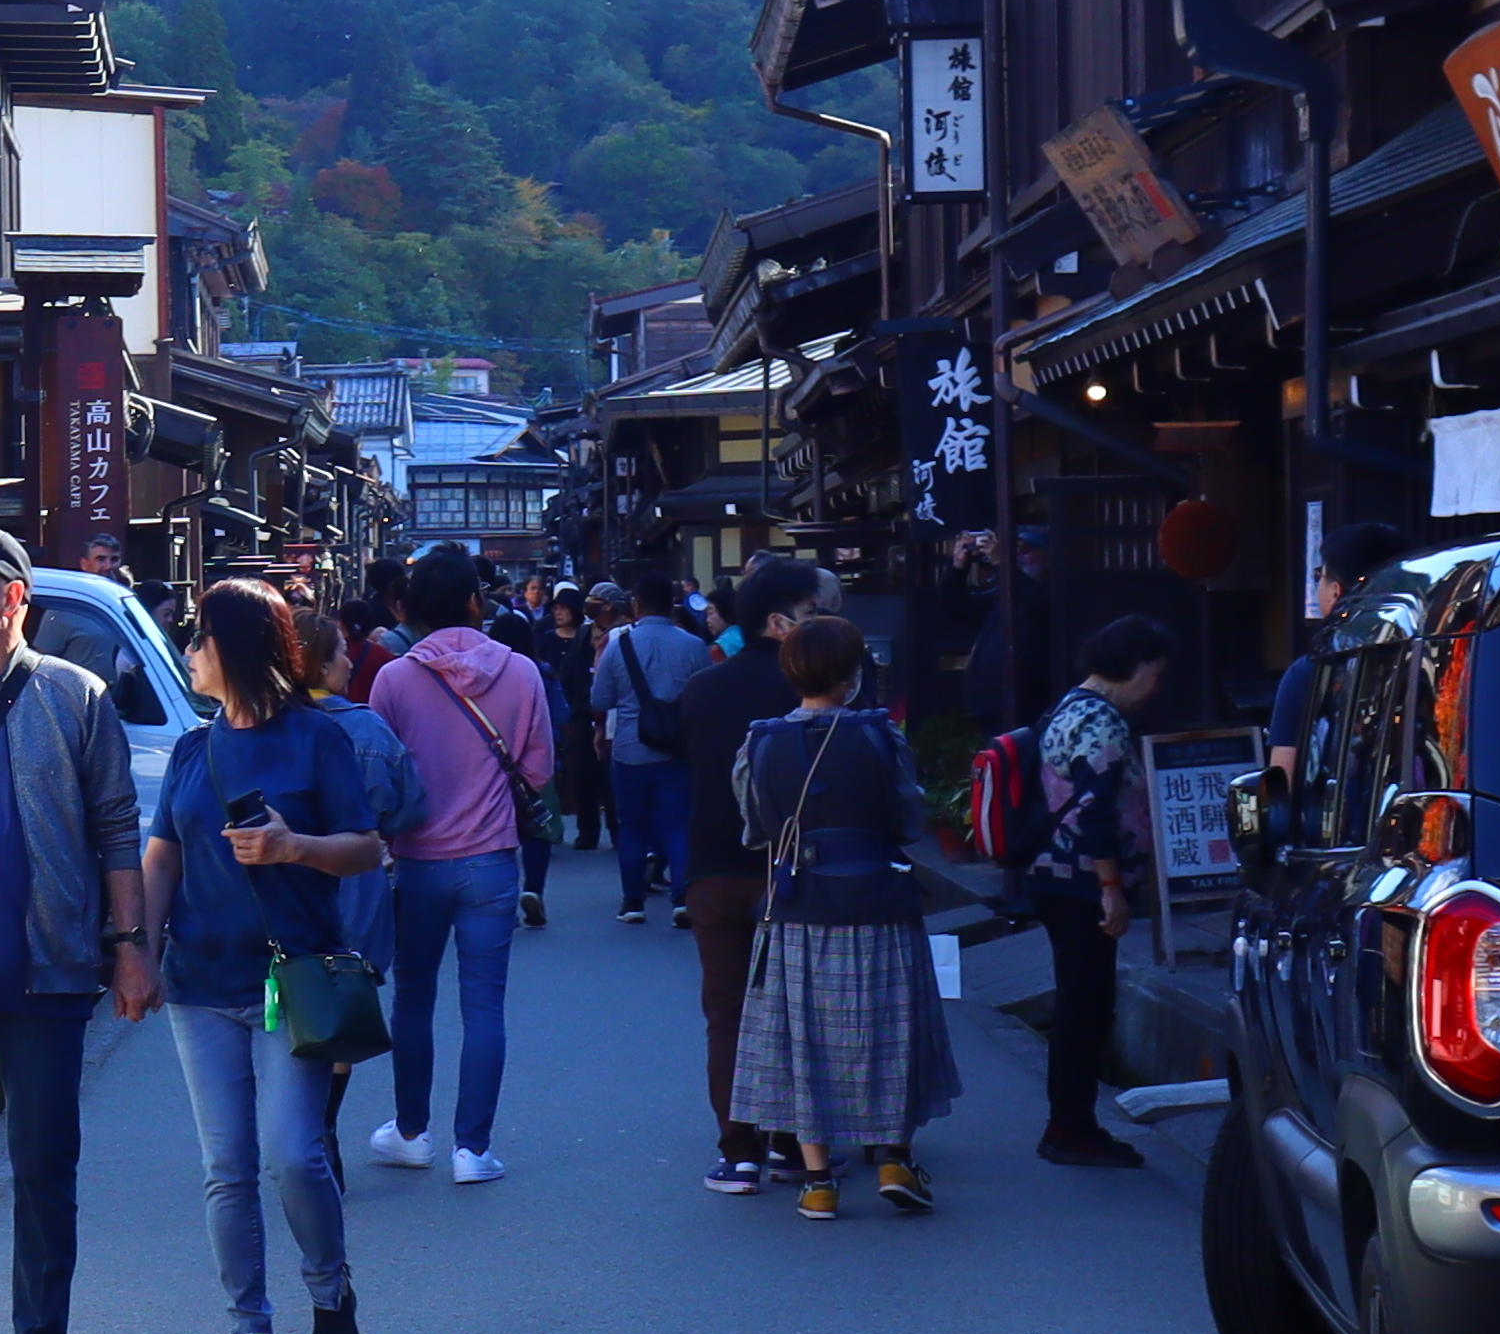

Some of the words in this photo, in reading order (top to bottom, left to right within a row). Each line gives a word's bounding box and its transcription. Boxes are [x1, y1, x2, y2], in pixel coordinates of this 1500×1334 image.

[947, 42, 977, 102] 旅館
[69, 400, 81, 471] TAKAYAMA
[927, 346, 993, 475] 旅館
[69, 474, 81, 509] CAFE
[85, 398, 112, 521] 高山カフェ
[1163, 773, 1200, 867] 地酒蔵
[1191, 877, 1214, 888] TAX
